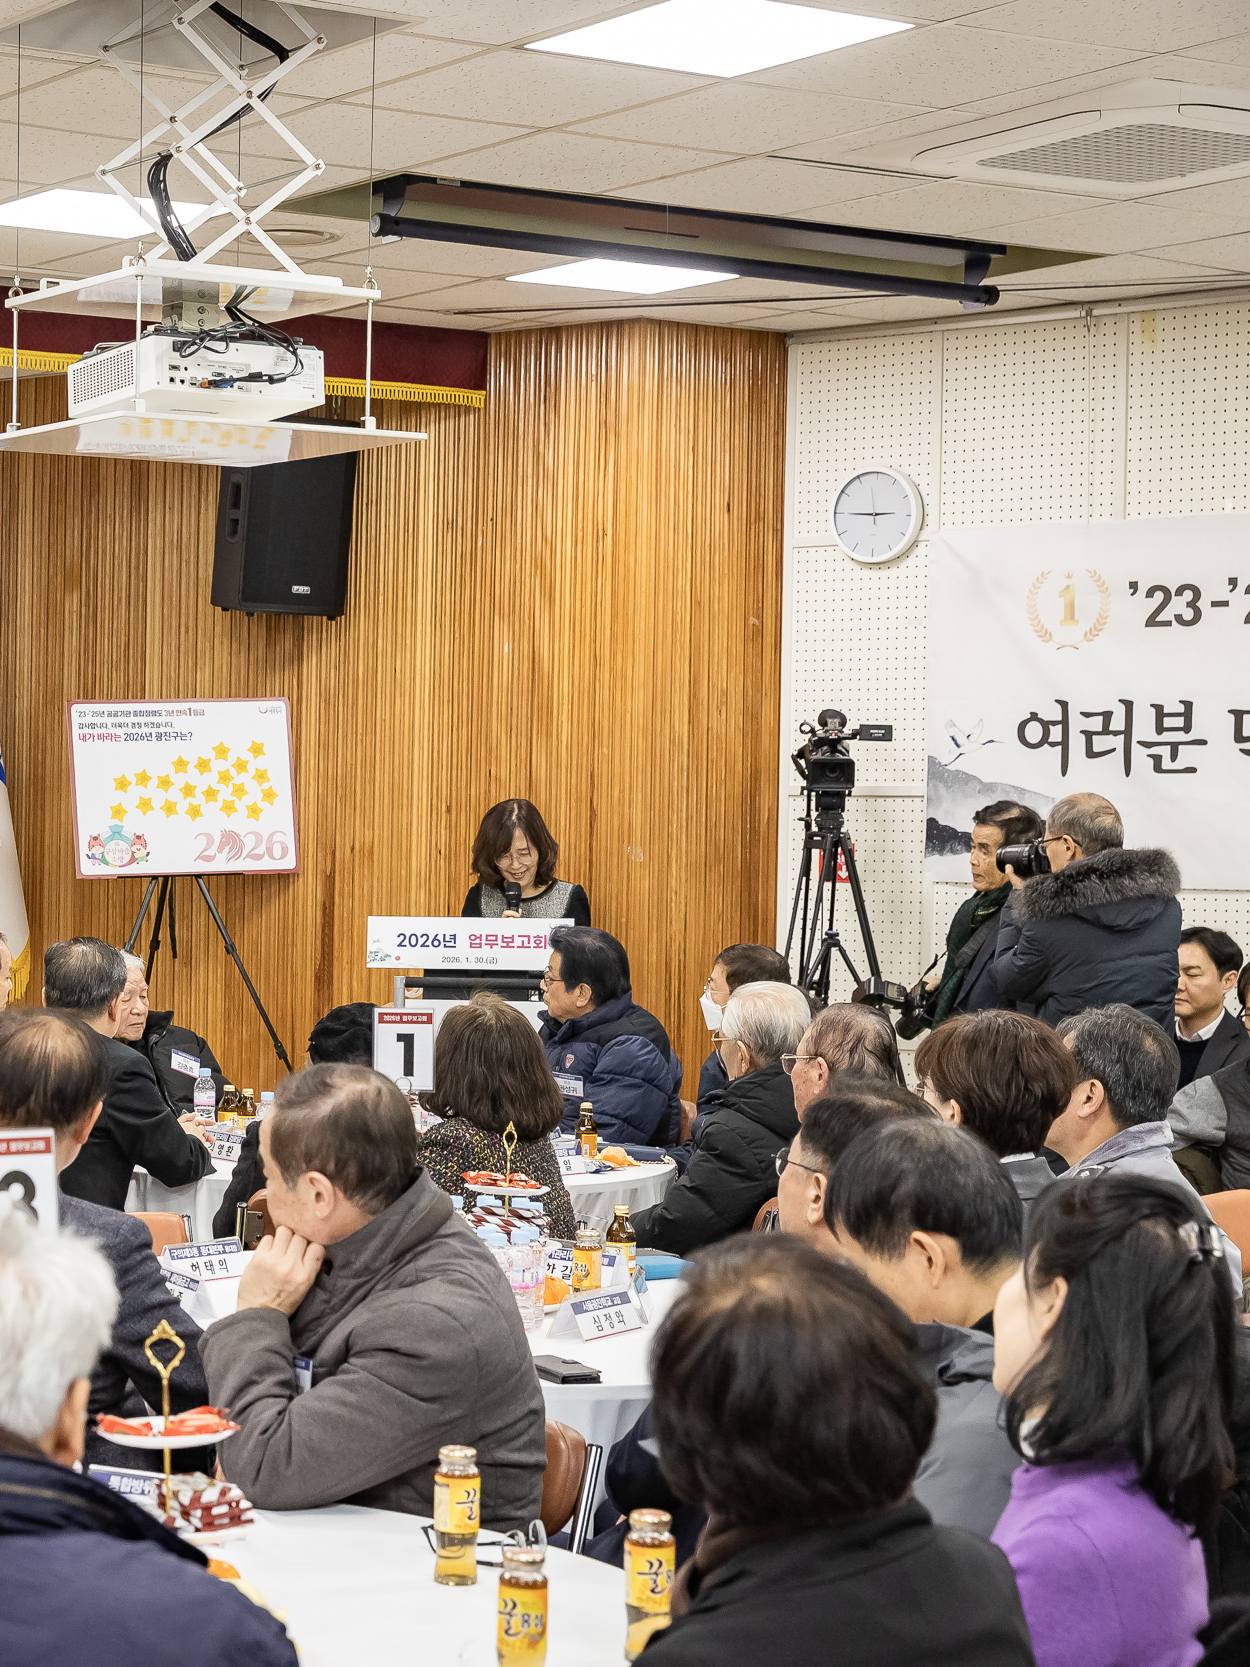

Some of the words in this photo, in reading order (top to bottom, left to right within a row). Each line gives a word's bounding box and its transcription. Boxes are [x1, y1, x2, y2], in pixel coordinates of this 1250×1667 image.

[78, 732, 95, 743] 내가
[97, 732, 122, 742] 바라는
[123, 732, 153, 742] 2026년
[155, 731, 193, 742] 광진구는?
[1017, 699, 1208, 778] 여러분
[396, 933, 457, 949] 2026년
[468, 933, 548, 950] 업무보고회
[474, 956, 498, 965] 30.(금)
[396, 1033, 415, 1077] 1
